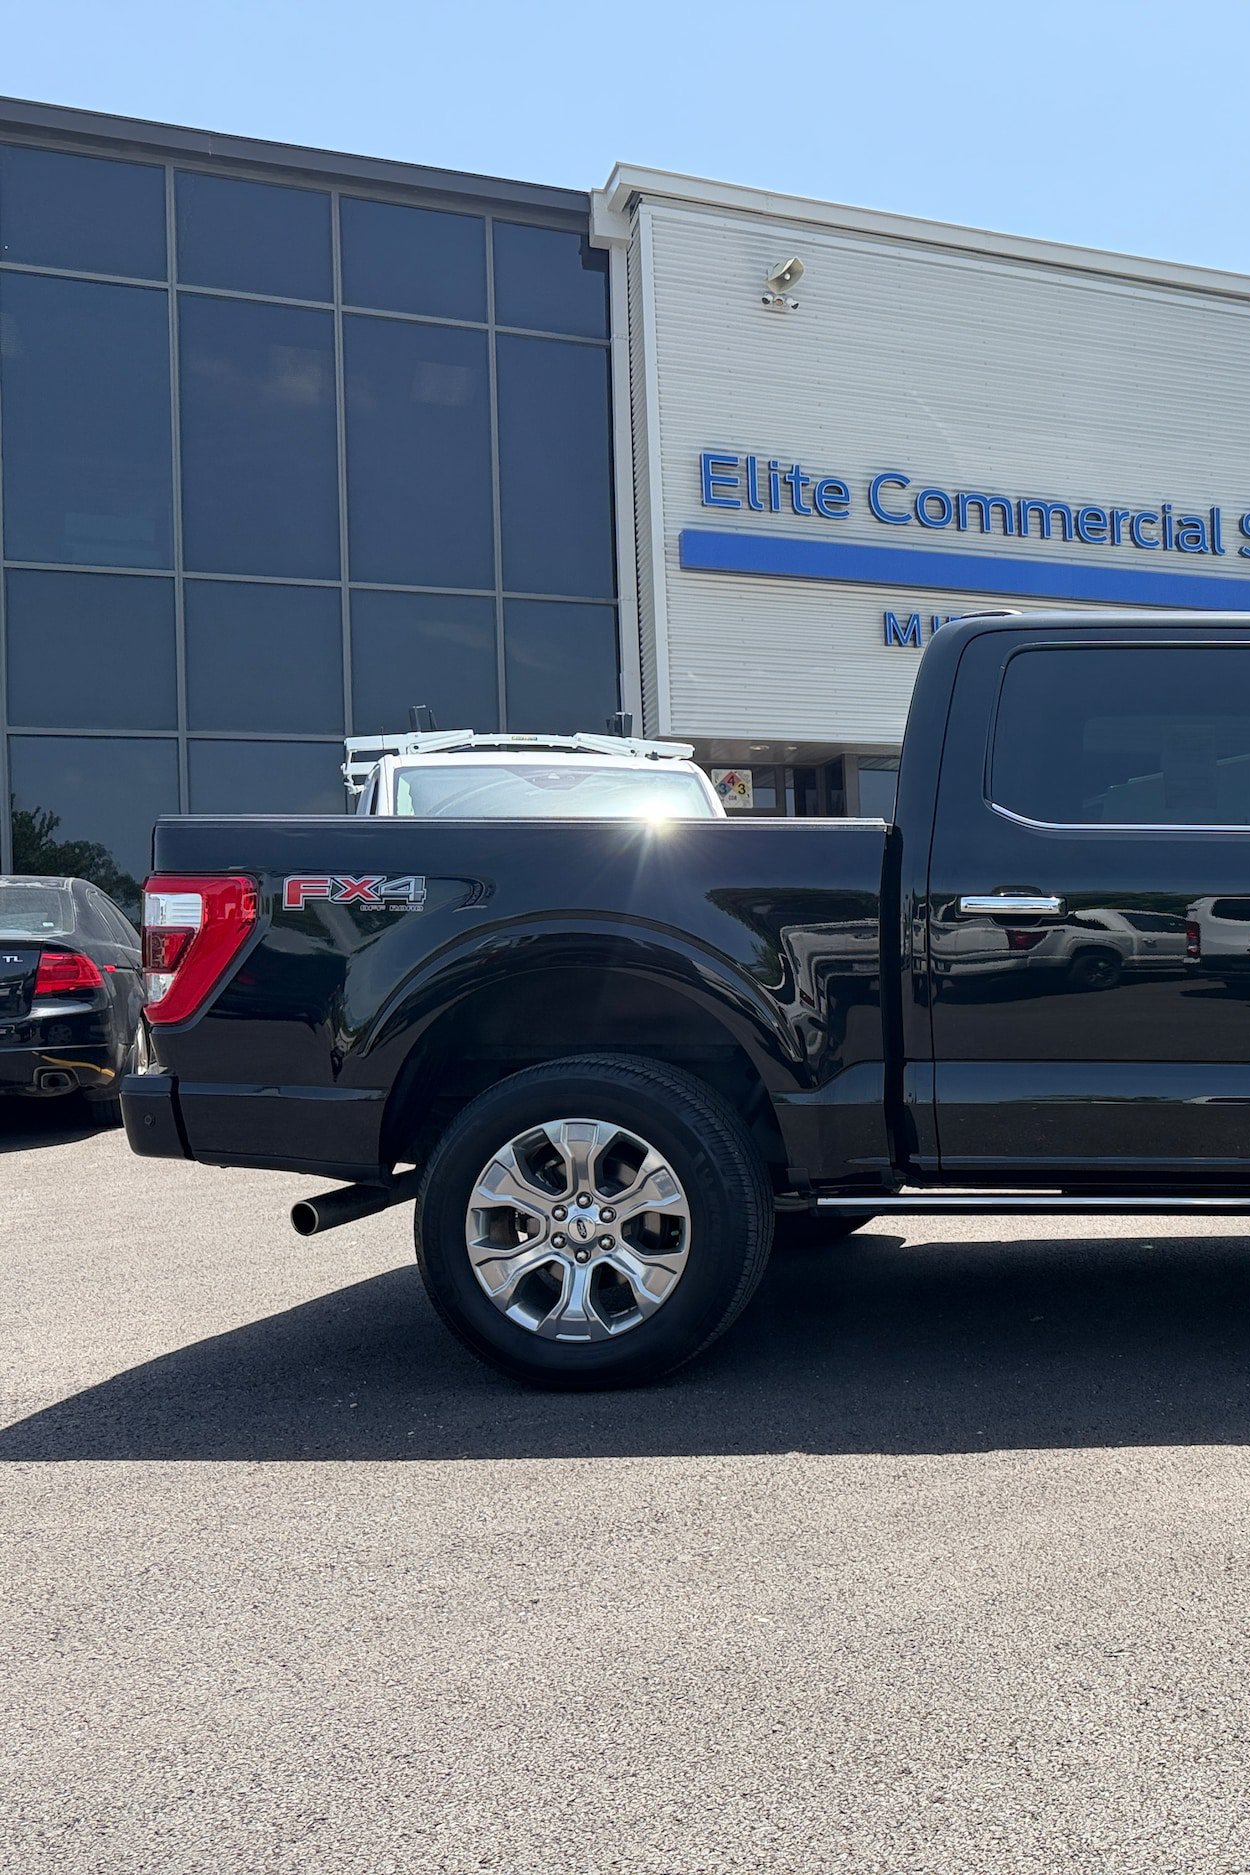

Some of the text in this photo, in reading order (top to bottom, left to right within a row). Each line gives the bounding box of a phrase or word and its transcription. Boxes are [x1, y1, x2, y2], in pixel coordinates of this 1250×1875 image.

[700, 452, 851, 520] Elite
[868, 471, 1225, 556] Commercial
[727, 775, 735, 786] 4
[738, 783, 746, 795] 3
[283, 875, 427, 911] FX4
[2, 955, 24, 963] TL
